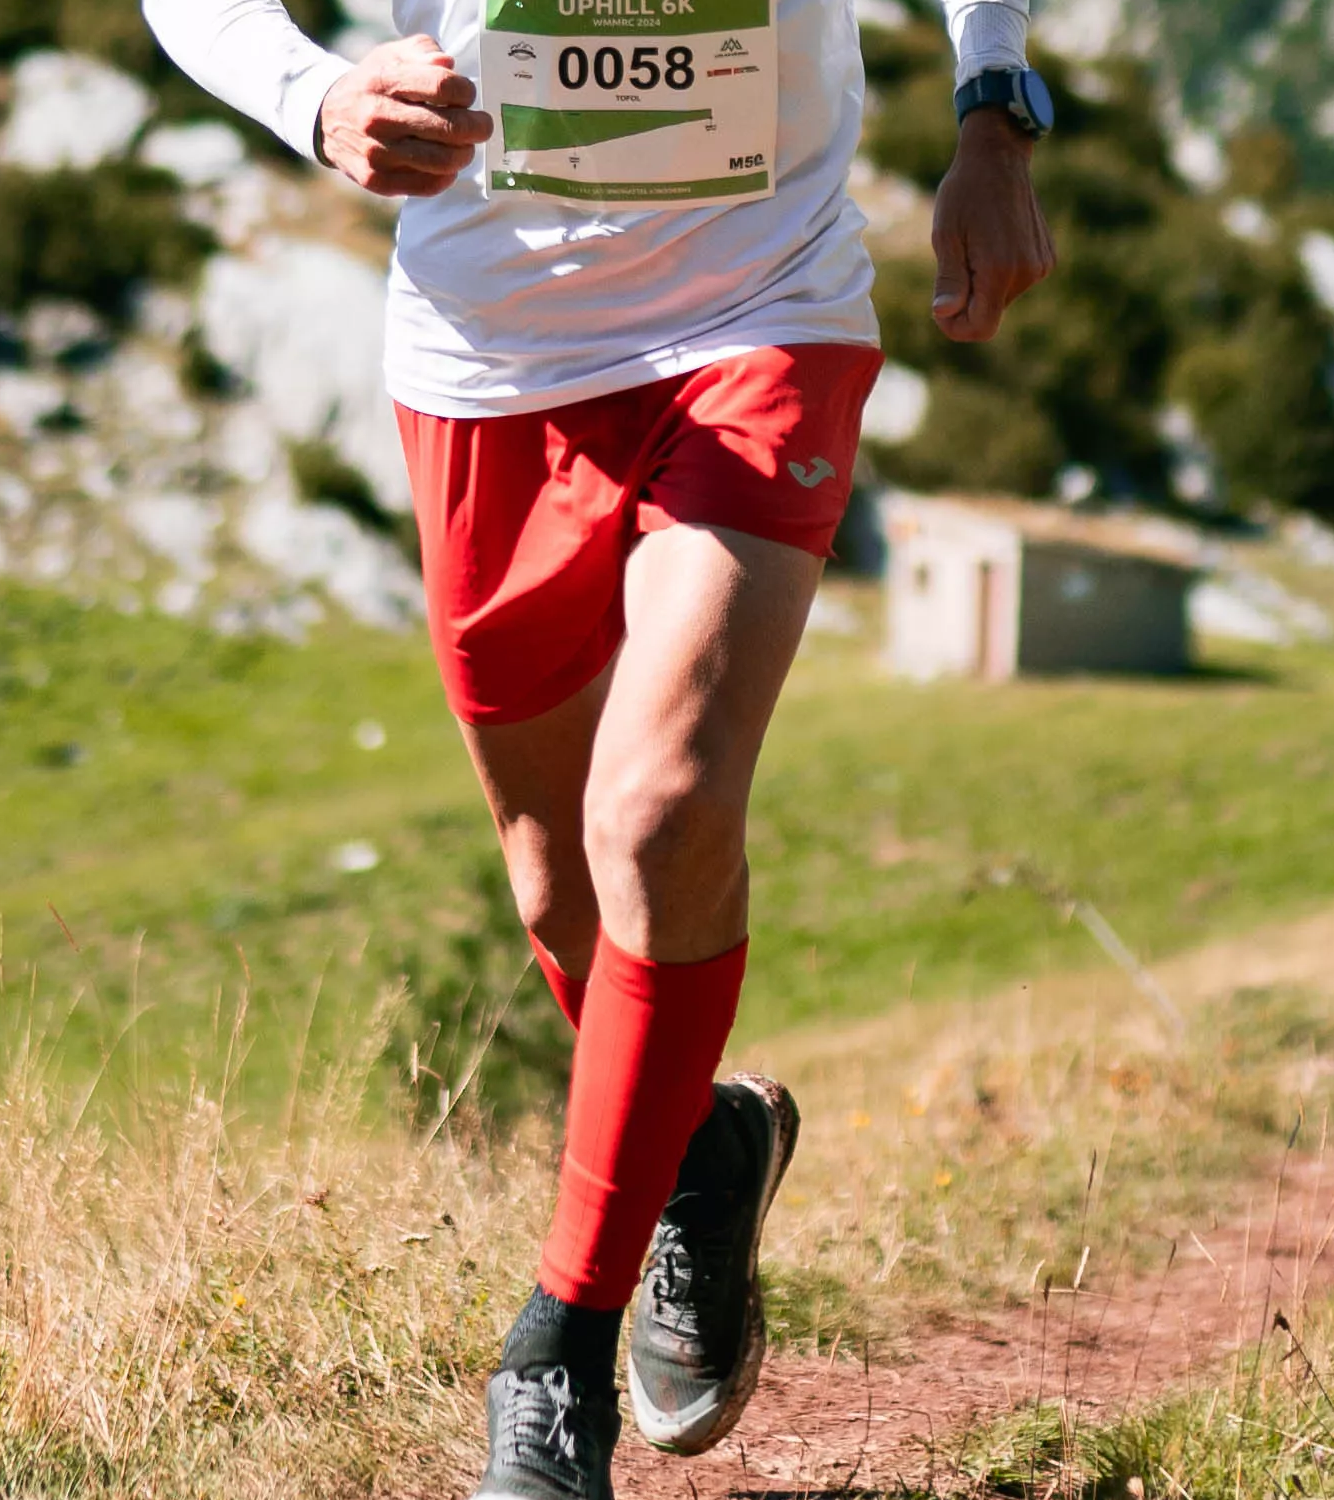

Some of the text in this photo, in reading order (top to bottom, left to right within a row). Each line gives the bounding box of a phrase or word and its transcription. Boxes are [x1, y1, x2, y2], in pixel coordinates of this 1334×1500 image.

[593, 18, 661, 27] WMMRC 2024
[558, 46, 695, 90] 0058
